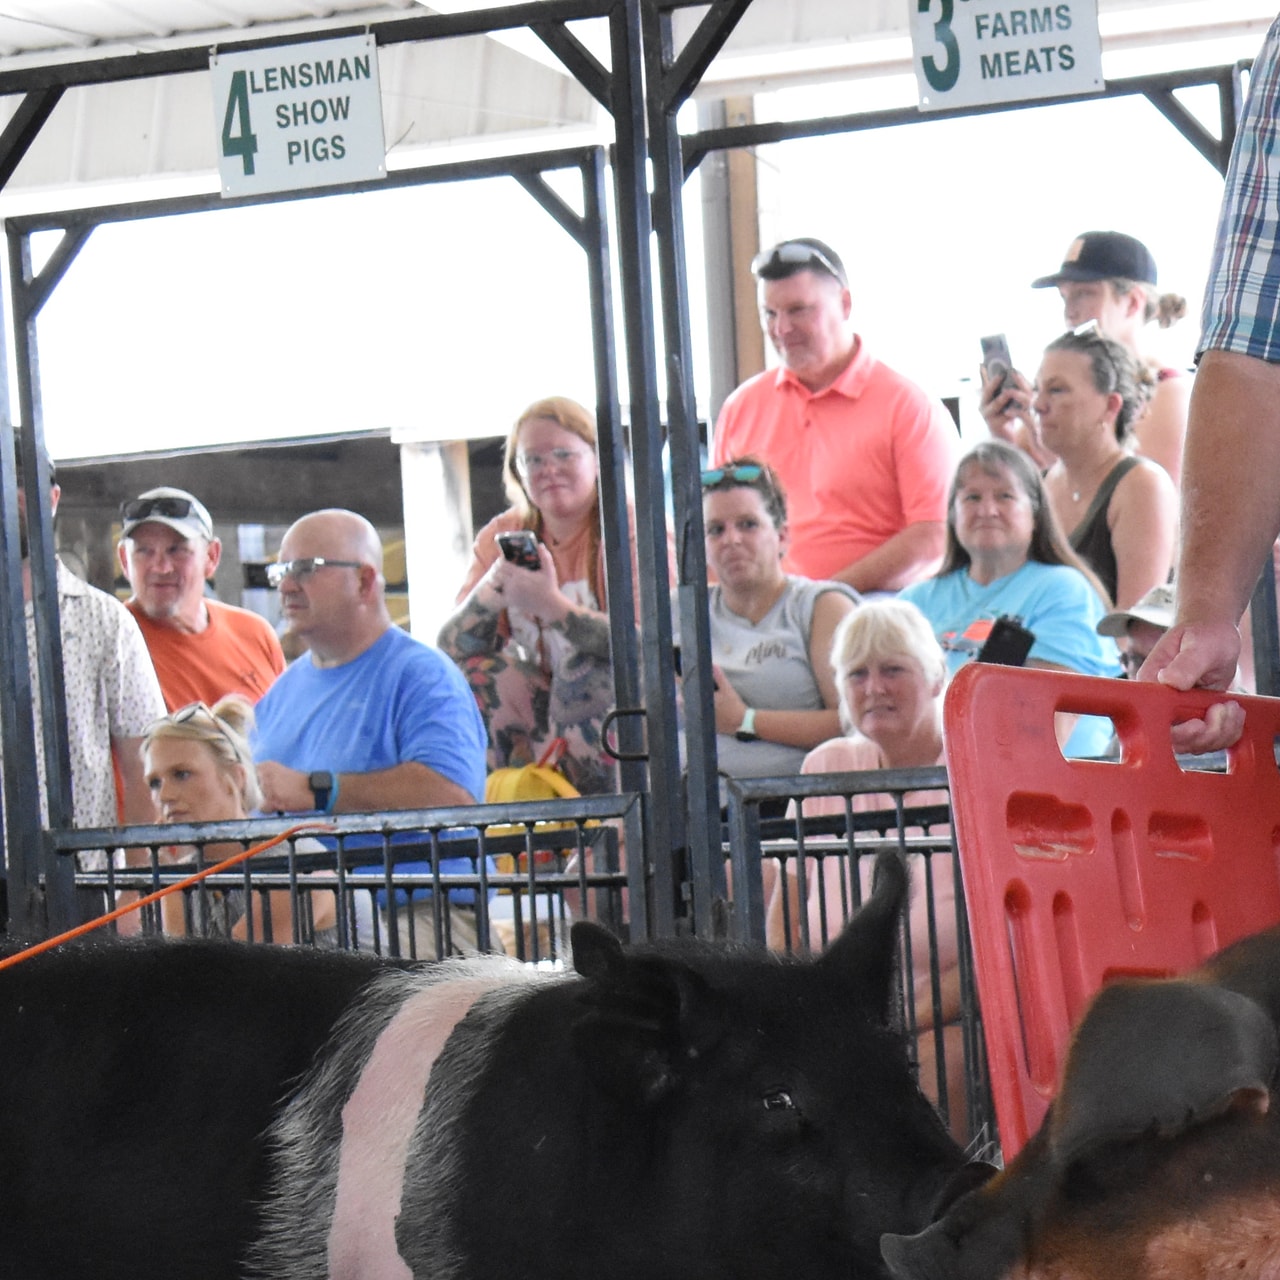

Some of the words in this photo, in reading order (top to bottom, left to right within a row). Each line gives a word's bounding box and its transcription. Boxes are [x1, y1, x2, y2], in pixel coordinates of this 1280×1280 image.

[975, 4, 1072, 40] FARMS
[918, 0, 960, 92] 3
[980, 44, 1075, 80] MEATS
[250, 54, 371, 95] LENSMAN
[222, 69, 258, 176] 4
[276, 96, 350, 129] SHOW
[287, 135, 346, 165] PIGS
